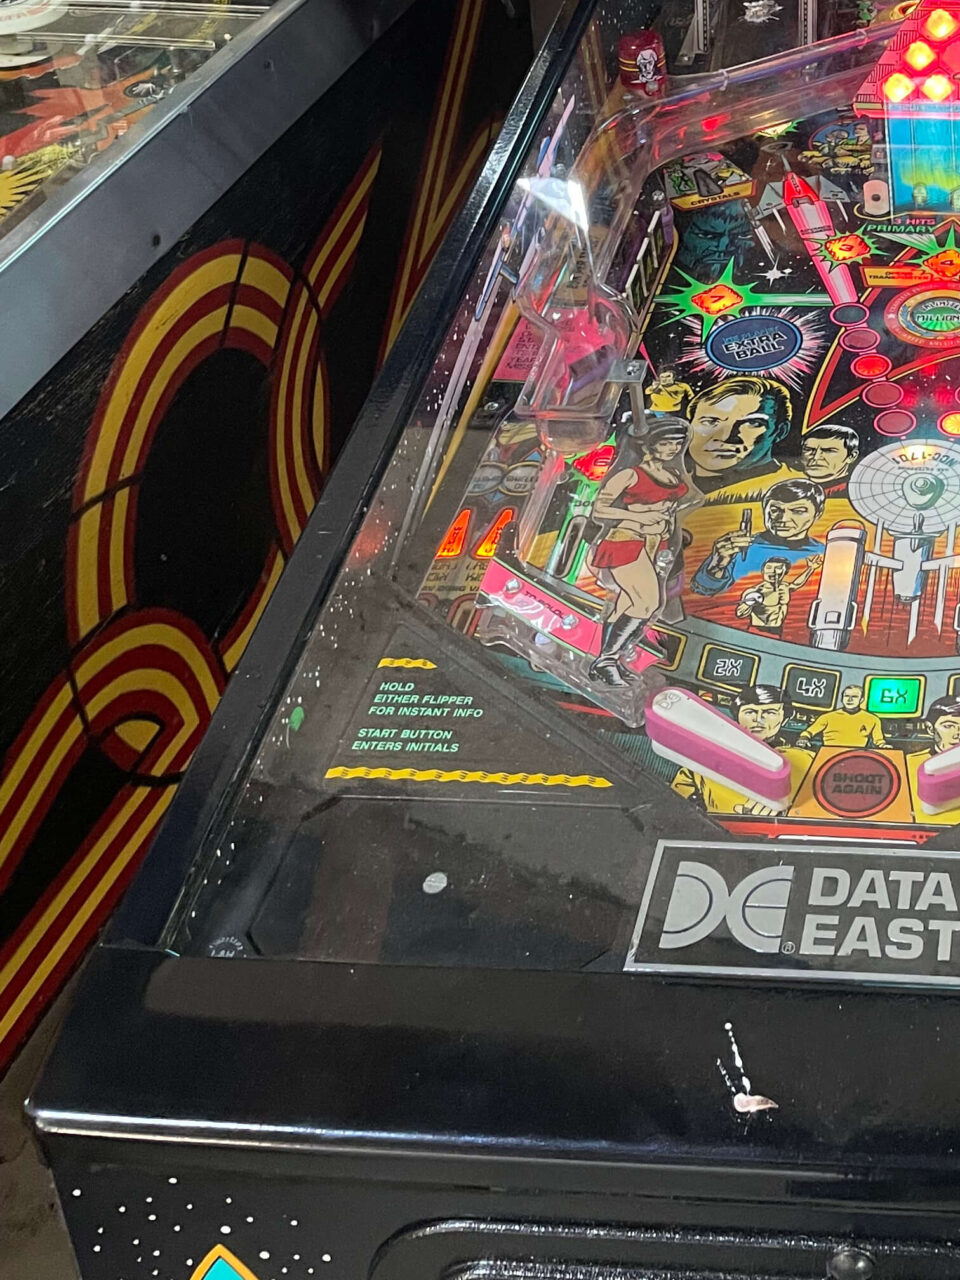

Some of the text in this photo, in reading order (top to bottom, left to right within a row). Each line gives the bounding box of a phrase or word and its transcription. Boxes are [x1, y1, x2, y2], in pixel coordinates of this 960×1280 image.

[690, 191, 741, 206] CRYSTALS
[866, 224, 935, 233] PRIMARY
[722, 331, 787, 354] EXTRA
[734, 341, 785, 361] BALL
[892, 452, 959, 467] NCC-1701
[379, 682, 415, 692] HOLD
[713, 657, 743, 677] 2X
[796, 677, 827, 698] 4X
[879, 688, 908, 705] 6X
[373, 694, 473, 706] EITHER FLIPPER
[368, 706, 484, 718] FOR INSTANT INFO
[357, 728, 453, 740] START BUTTON
[351, 740, 460, 753] ENTERS INITIALS
[832, 772, 886, 784] SHOOT
[832, 784, 883, 795] AGAIN
[807, 866, 959, 912] DATA
